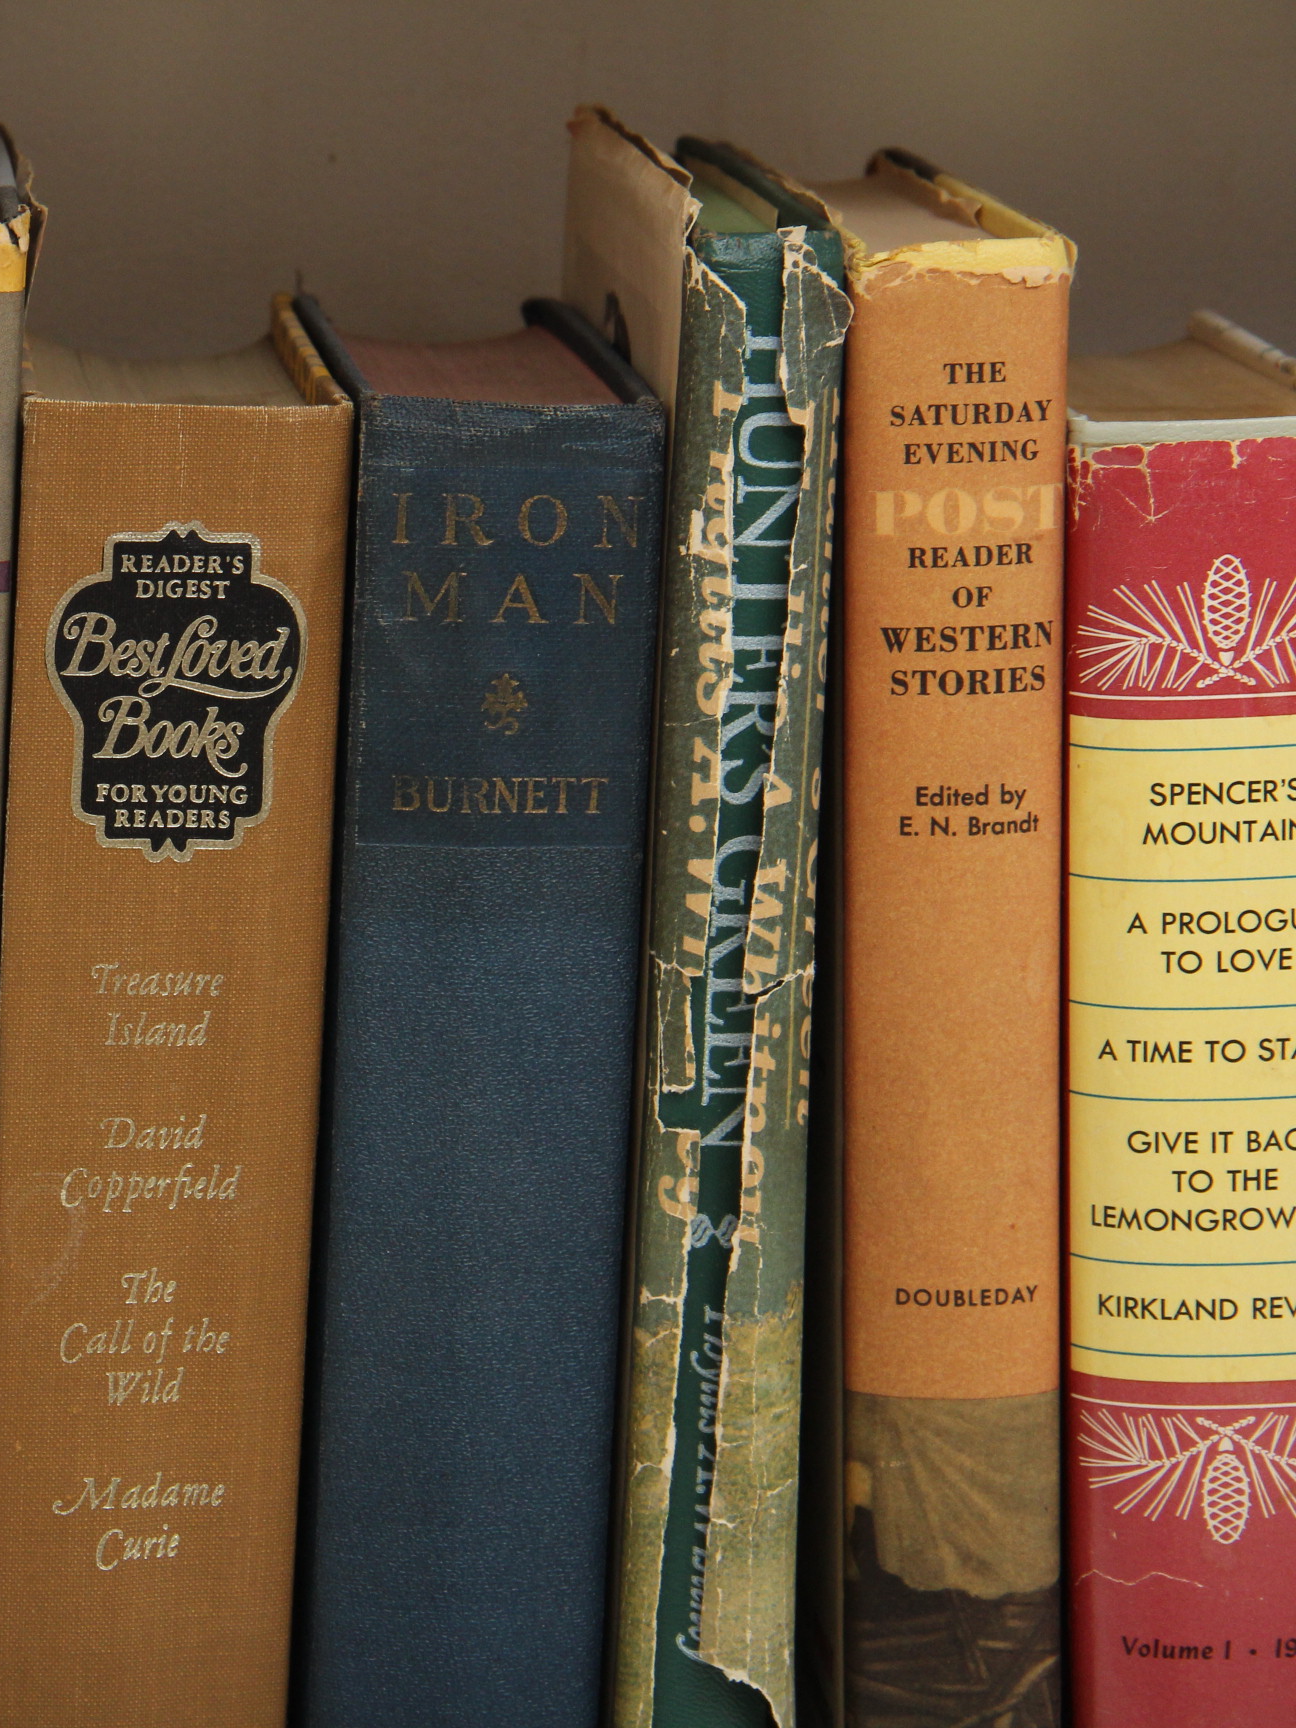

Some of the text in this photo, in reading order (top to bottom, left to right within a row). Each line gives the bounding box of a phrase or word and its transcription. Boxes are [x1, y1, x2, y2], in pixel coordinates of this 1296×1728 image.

[943, 360, 1008, 385] THE
[889, 399, 1052, 428] SATURDAY
[902, 438, 1040, 466] EVENING
[390, 491, 645, 549] IRON
[870, 481, 1064, 537] POST
[120, 553, 245, 575] READER'S
[907, 542, 1034, 570] READER
[135, 579, 231, 600] DIGEST
[402, 570, 625, 626] MAN
[951, 585, 993, 609] OF
[879, 619, 1054, 654] WESTERN
[59, 610, 294, 699] Best Loved
[890, 664, 1046, 698] STORIES
[91, 694, 248, 779] Books
[94, 783, 250, 806] FOR YOUNG
[390, 774, 610, 815] BURNETT
[915, 782, 1027, 810] Edited by
[1149, 778, 1296, 807] SPENCER'S
[113, 808, 232, 830] READERS
[968, 811, 1040, 837] Brandt
[1126, 911, 1149, 935] A
[1160, 947, 1293, 975] TO LOVE
[90, 961, 225, 997] Treasure
[700, 834, 762, 1147] GREEN
[103, 1010, 212, 1047] Island
[1097, 1038, 1118, 1062] A
[1126, 1039, 1193, 1064] TIME
[1204, 1038, 1247, 1064] TO
[99, 1113, 208, 1150] David
[1127, 1130, 1199, 1155] GIVE
[1210, 1131, 1234, 1154] IT
[59, 1161, 243, 1214] Copperfield
[1171, 1168, 1279, 1194] TO THE
[120, 1266, 178, 1305] The
[894, 1284, 1039, 1308] DOUBLEDAY
[1097, 1293, 1239, 1322] KIRKLAND
[59, 1316, 231, 1365] Call of the
[104, 1366, 186, 1407] Wild
[51, 1470, 226, 1517] Madame
[95, 1522, 181, 1572] Curie
[1121, 1634, 1215, 1661] Volume
